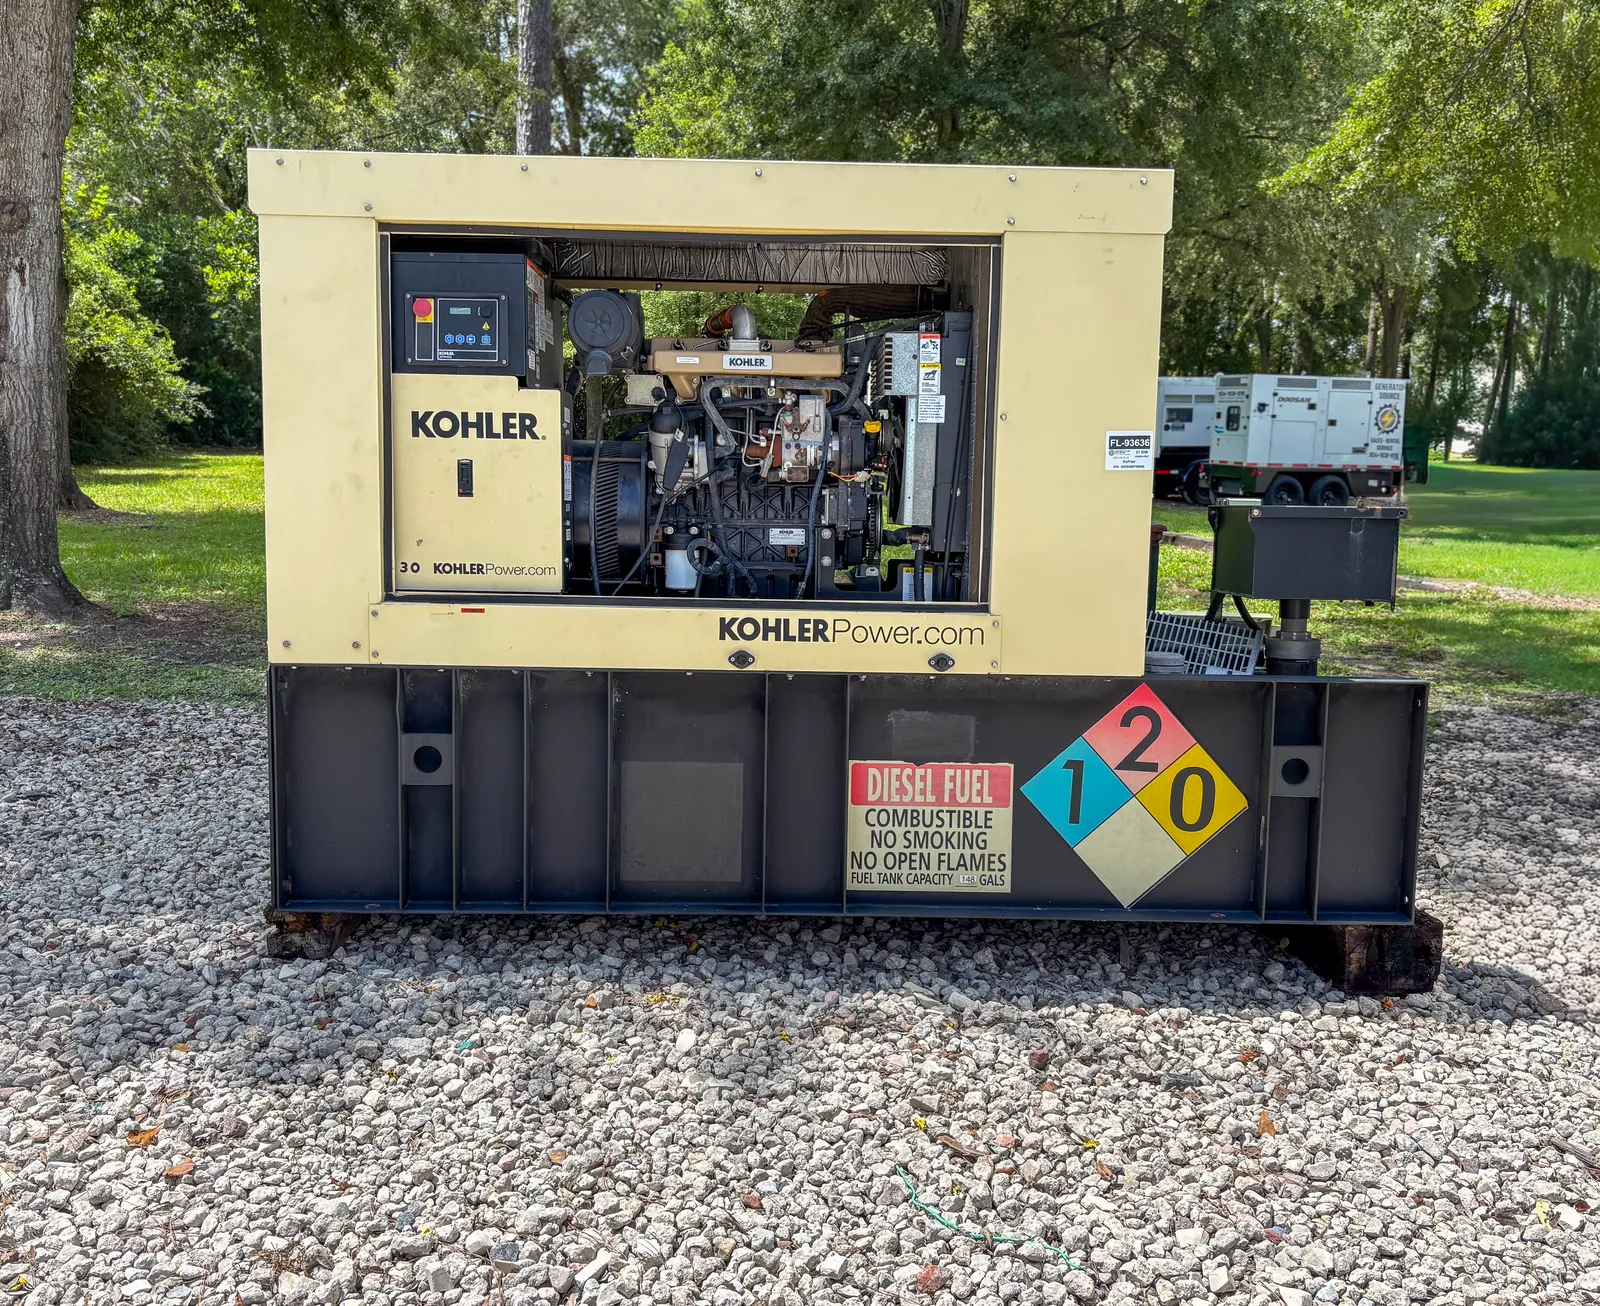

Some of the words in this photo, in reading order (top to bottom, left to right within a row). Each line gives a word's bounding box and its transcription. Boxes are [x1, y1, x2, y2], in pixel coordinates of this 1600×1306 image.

[729, 357, 767, 367] KOHLER
[1379, 392, 1400, 400] SOURCE
[1110, 439, 1150, 447] FL-93636
[433, 562, 557, 576] KOHLERPower.com
[718, 616, 985, 645] KOHLERPower.com
[1113, 705, 1163, 773] 2
[867, 767, 936, 803] DIESEL
[944, 768, 993, 804] FUEL
[1062, 759, 1085, 825] 1
[1169, 766, 1216, 832] 0
[864, 808, 993, 829] COMBUSTIBLE
[870, 830, 897, 849] NO
[903, 831, 988, 850] SMOKING
[851, 851, 877, 870] NO
[883, 852, 931, 871] OPEN
[937, 852, 1007, 872] FLAMES
[851, 872, 875, 885] FUEL
[877, 872, 903, 885] TANK
[906, 872, 954, 886] CAPACITY
[961, 875, 975, 884] 148
[979, 874, 1005, 887] GALS
